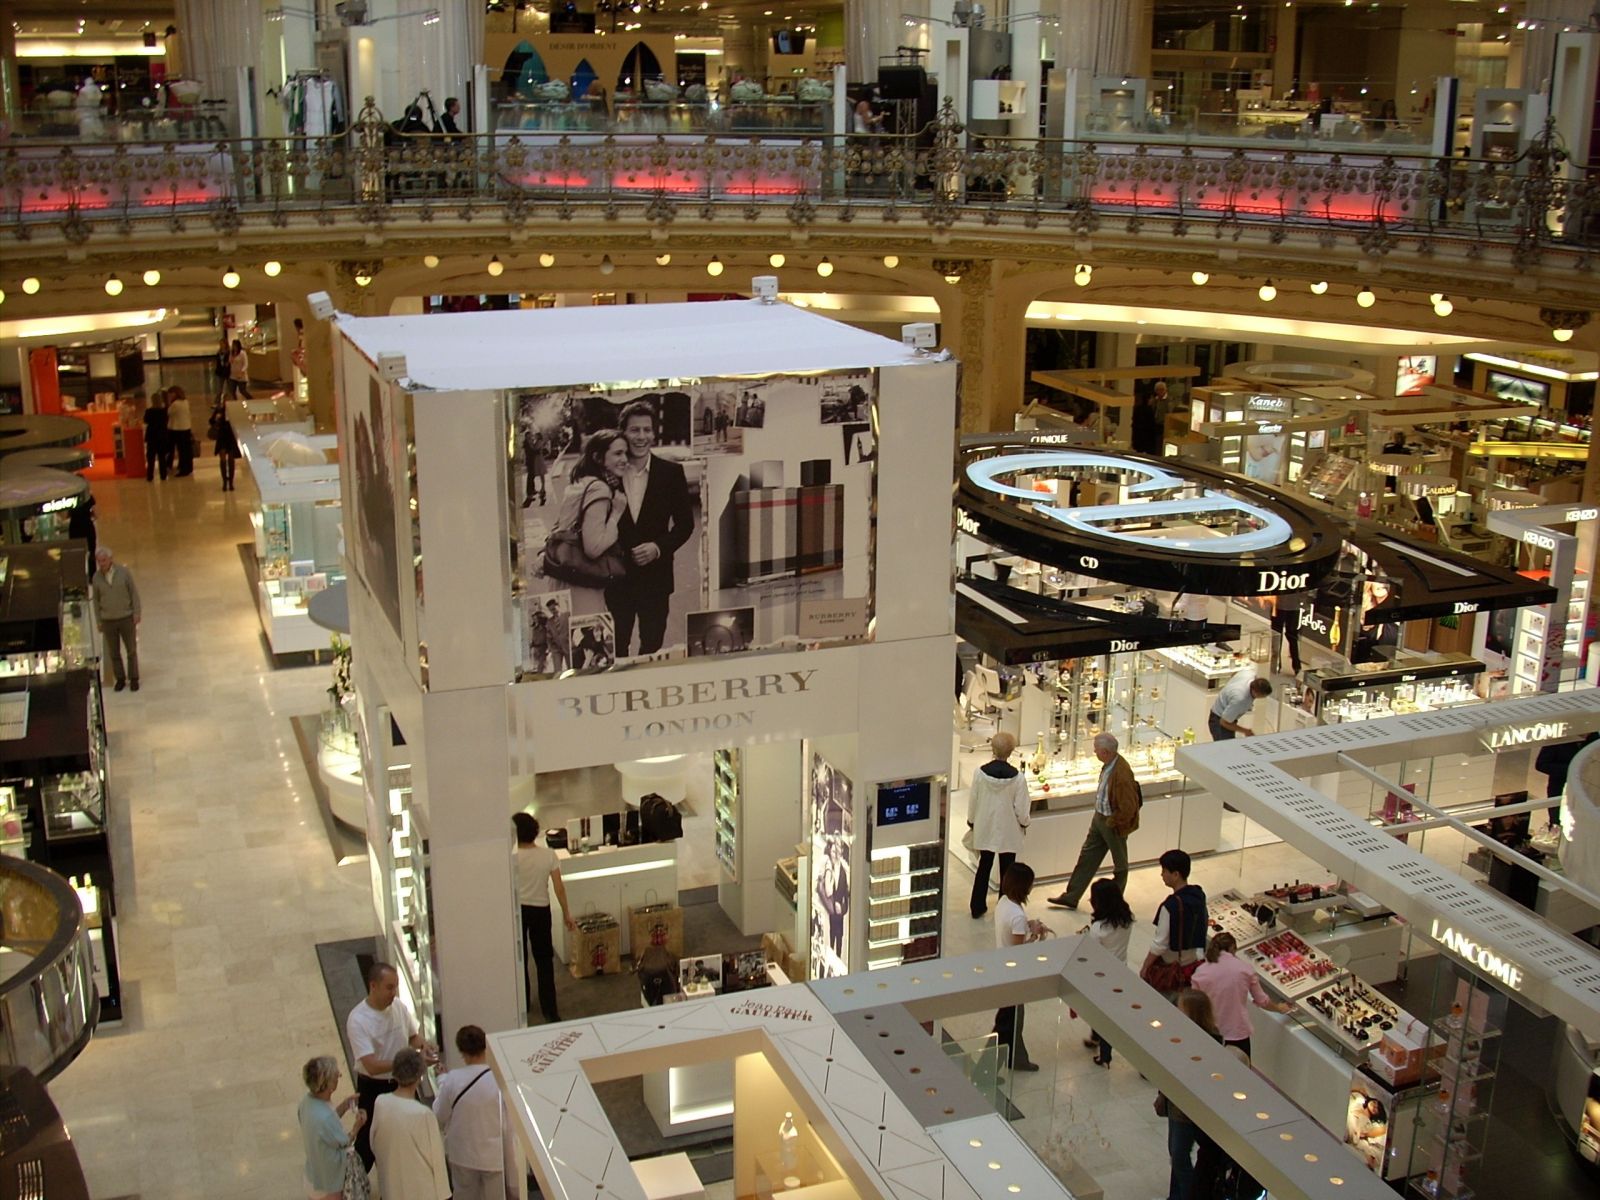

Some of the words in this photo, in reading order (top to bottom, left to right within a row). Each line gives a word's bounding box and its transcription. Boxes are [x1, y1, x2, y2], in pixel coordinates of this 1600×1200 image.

[956, 508, 981, 535] Dior
[1565, 508, 1598, 522] KENZO
[1523, 530, 1555, 550] KENZO
[1079, 555, 1099, 569] CD
[1256, 570, 1310, 592] Dior
[1453, 602, 1480, 614] Dior
[1110, 640, 1139, 652] Dior
[557, 669, 819, 720] BURBERRY
[622, 710, 755, 742] LONDON
